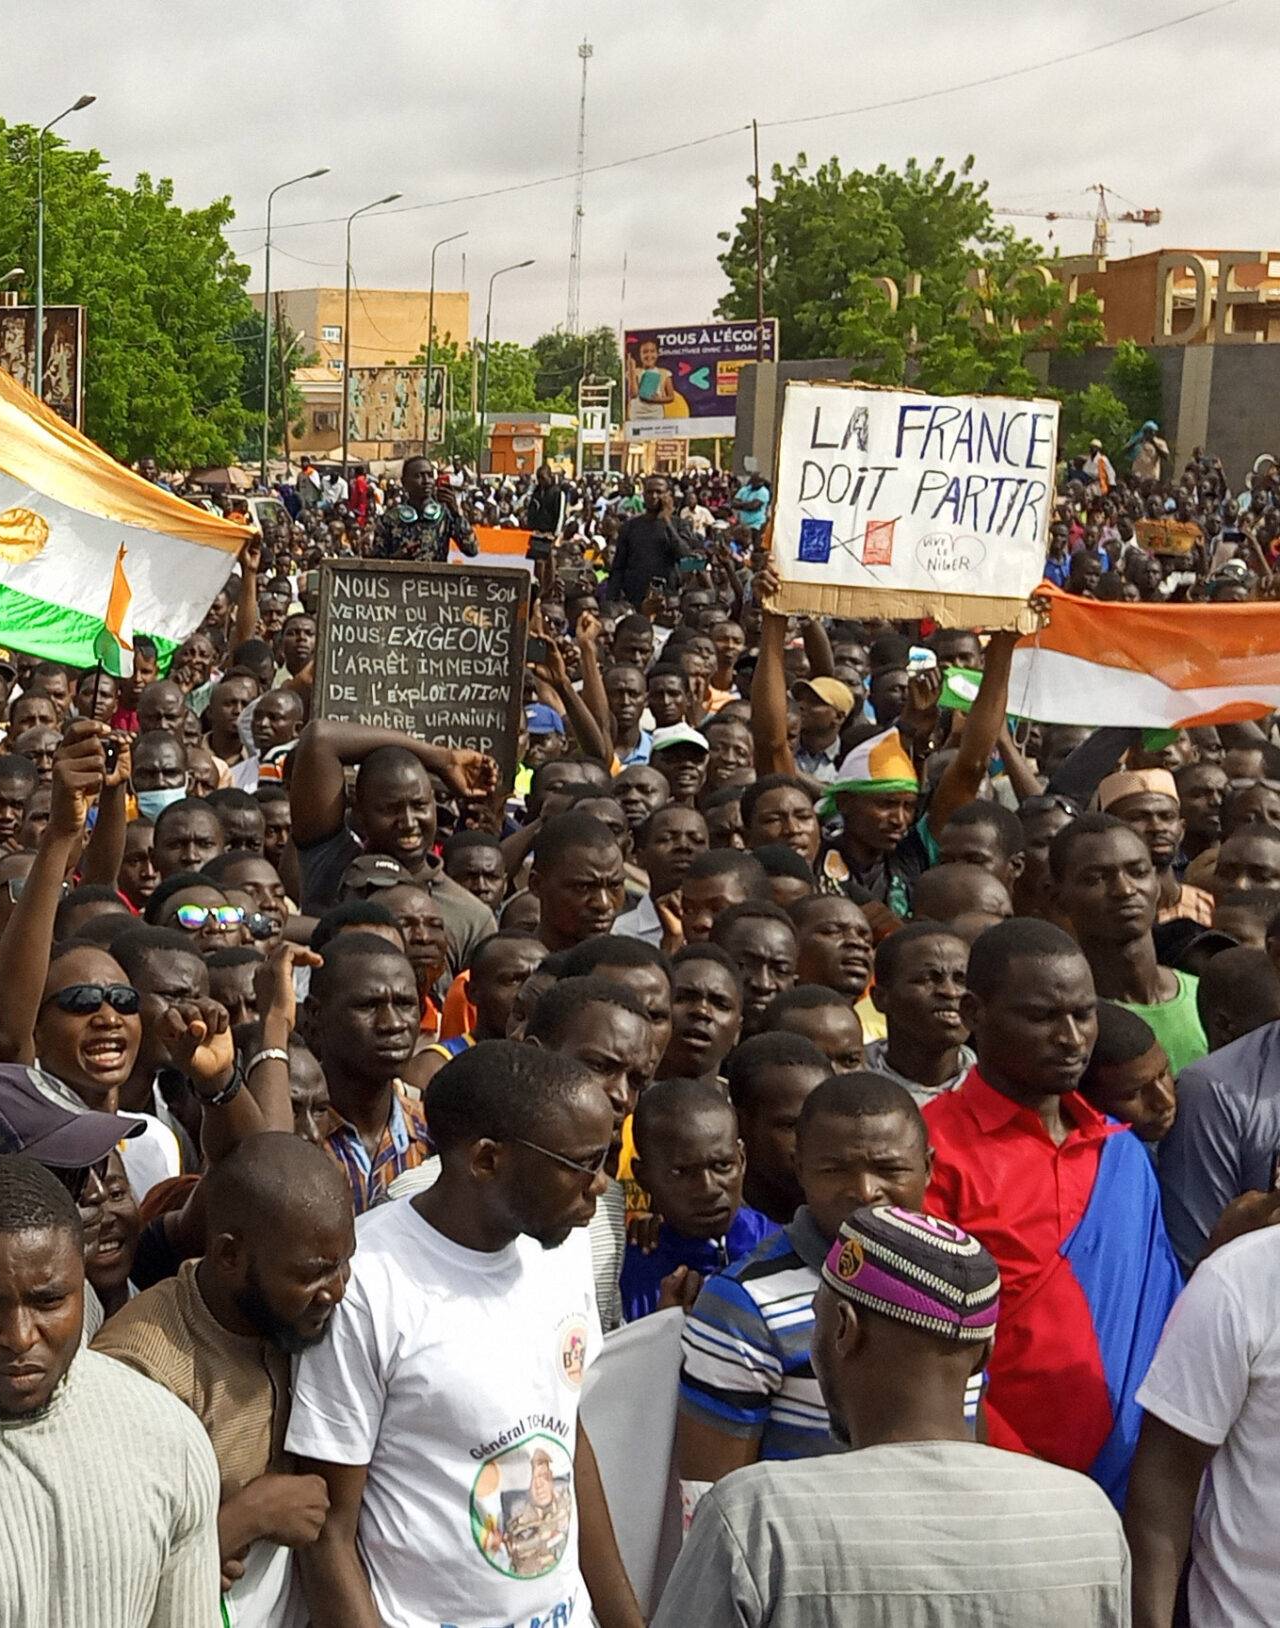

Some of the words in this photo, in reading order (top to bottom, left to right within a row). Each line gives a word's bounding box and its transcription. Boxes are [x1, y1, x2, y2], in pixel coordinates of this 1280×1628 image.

[657, 333, 697, 346] TOUS
[699, 329, 711, 344] À
[810, 405, 869, 453] LA
[895, 404, 1054, 470] FRANCE
[910, 469, 1047, 541] PARTIR
[333, 575, 390, 598] NOUS
[329, 603, 397, 622] VERAIN
[405, 606, 427, 623] DU
[331, 624, 380, 644] NOUS
[329, 684, 358, 701] DE
[469, 1419, 526, 1460] Général
